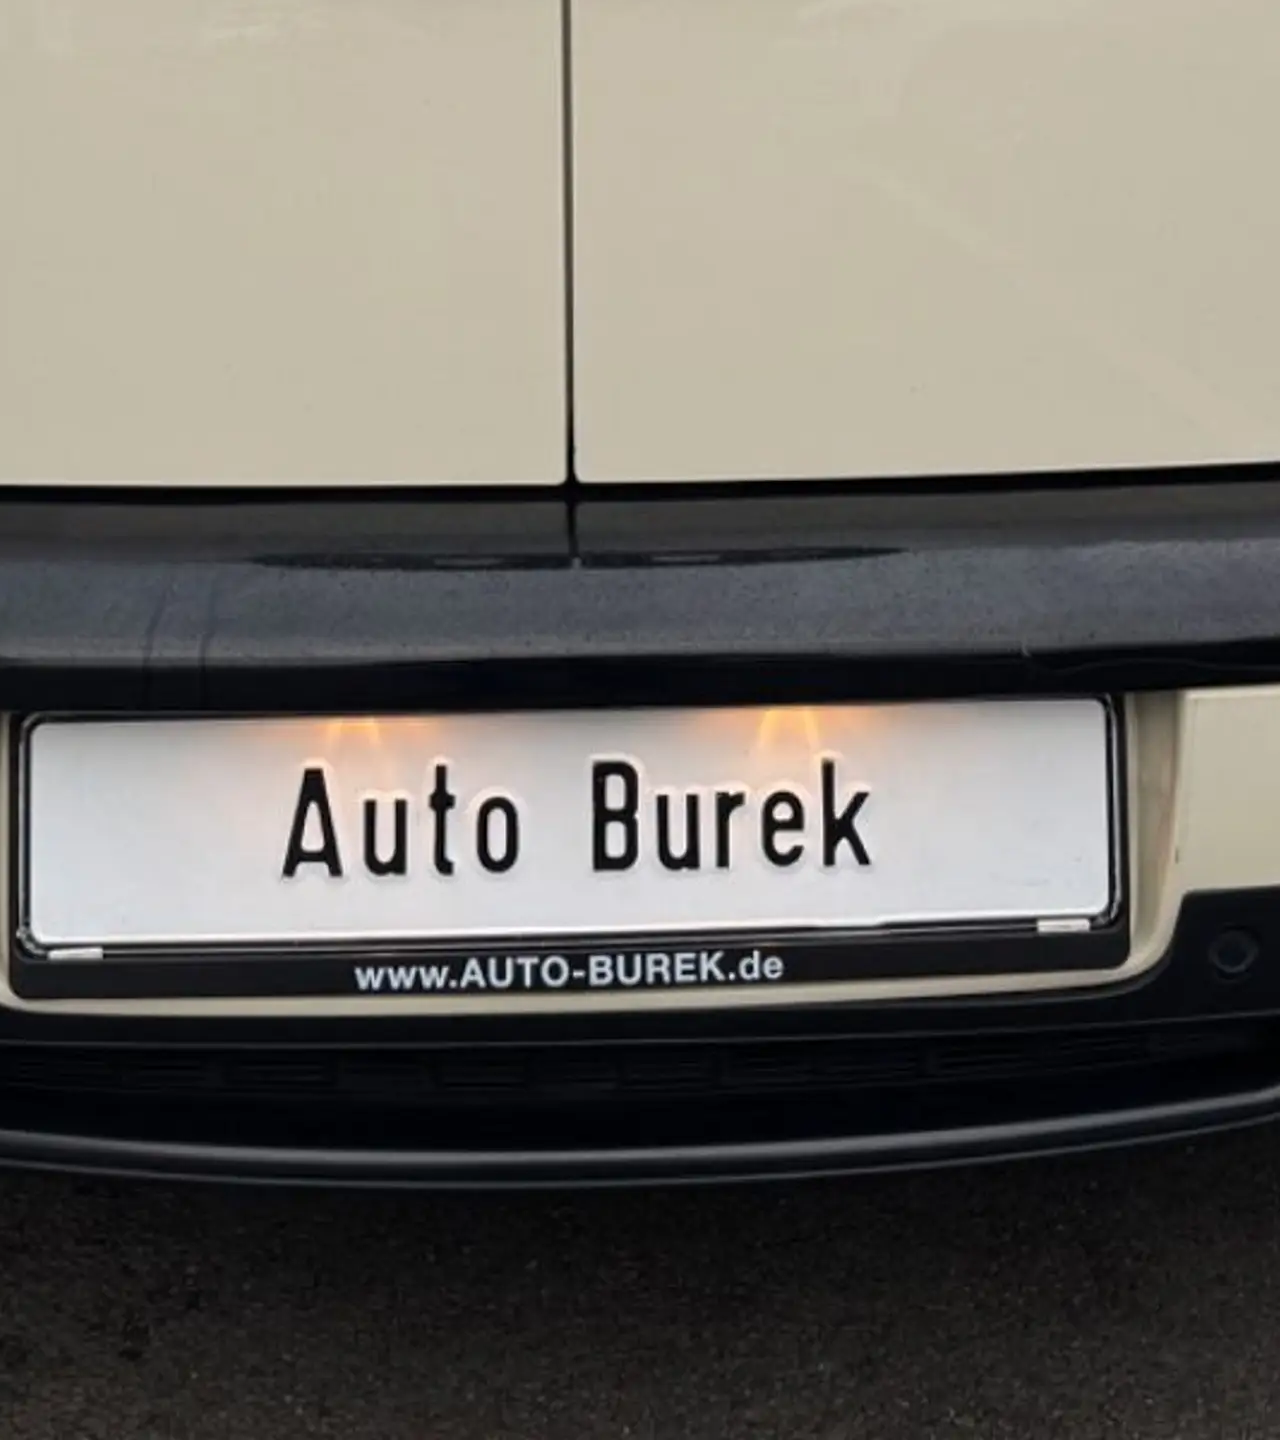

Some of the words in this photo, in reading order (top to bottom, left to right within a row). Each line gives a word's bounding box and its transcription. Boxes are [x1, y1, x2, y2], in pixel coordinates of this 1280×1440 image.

[281, 764, 520, 878] Auto
[591, 758, 872, 872] Burek
[353, 950, 785, 991] www.AUTO-BUREK.de
